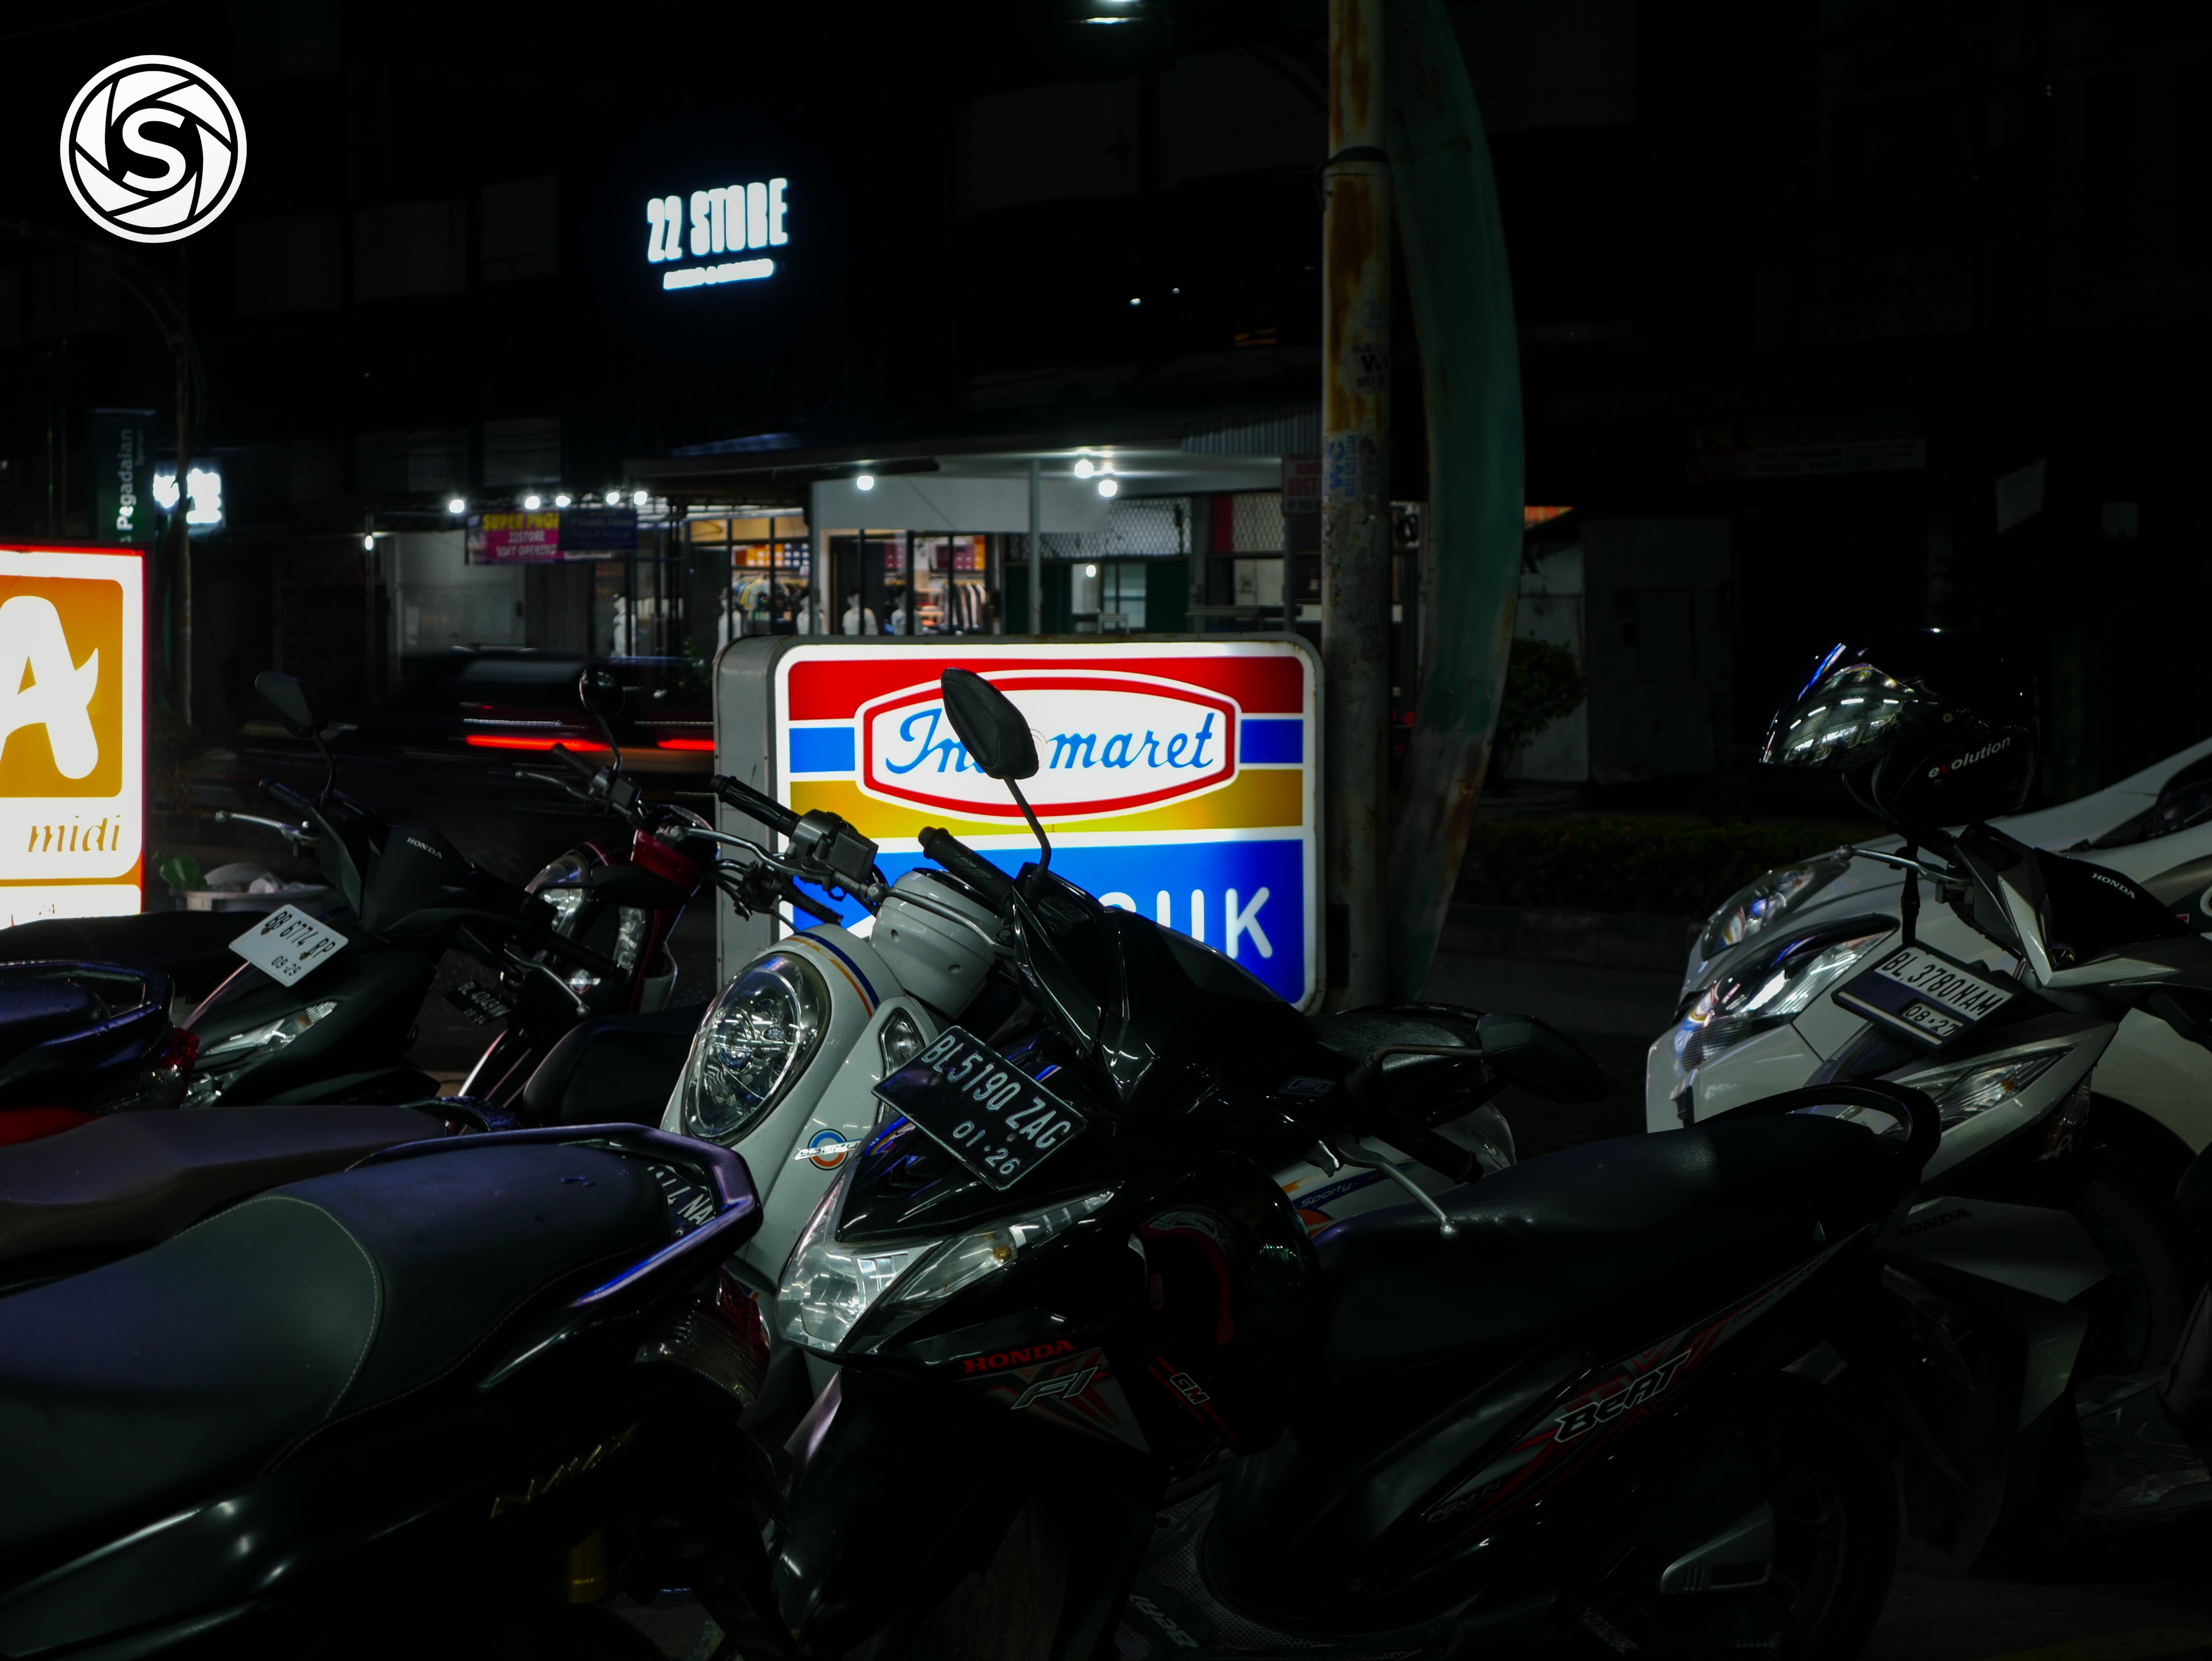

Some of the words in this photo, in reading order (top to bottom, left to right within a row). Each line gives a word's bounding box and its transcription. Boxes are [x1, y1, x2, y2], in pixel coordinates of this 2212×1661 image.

[647, 195, 683, 263] 22
[690, 178, 789, 256] STORE
[1330, 441, 1345, 490] WC
[885, 707, 1214, 774] Inmaret
[1928, 737, 2011, 778] evolution
[28, 815, 120, 853] midi
[406, 837, 443, 859] HONDA
[2091, 872, 2135, 900] HONDA
[265, 911, 292, 930] BB
[280, 921, 318, 948] 6774
[458, 981, 476, 996] BL
[1288, 1079, 1331, 1091] FI
[677, 1193, 715, 1226] NA
[962, 1338, 1078, 1374] HONDA
[1010, 1364, 1102, 1411] FI
